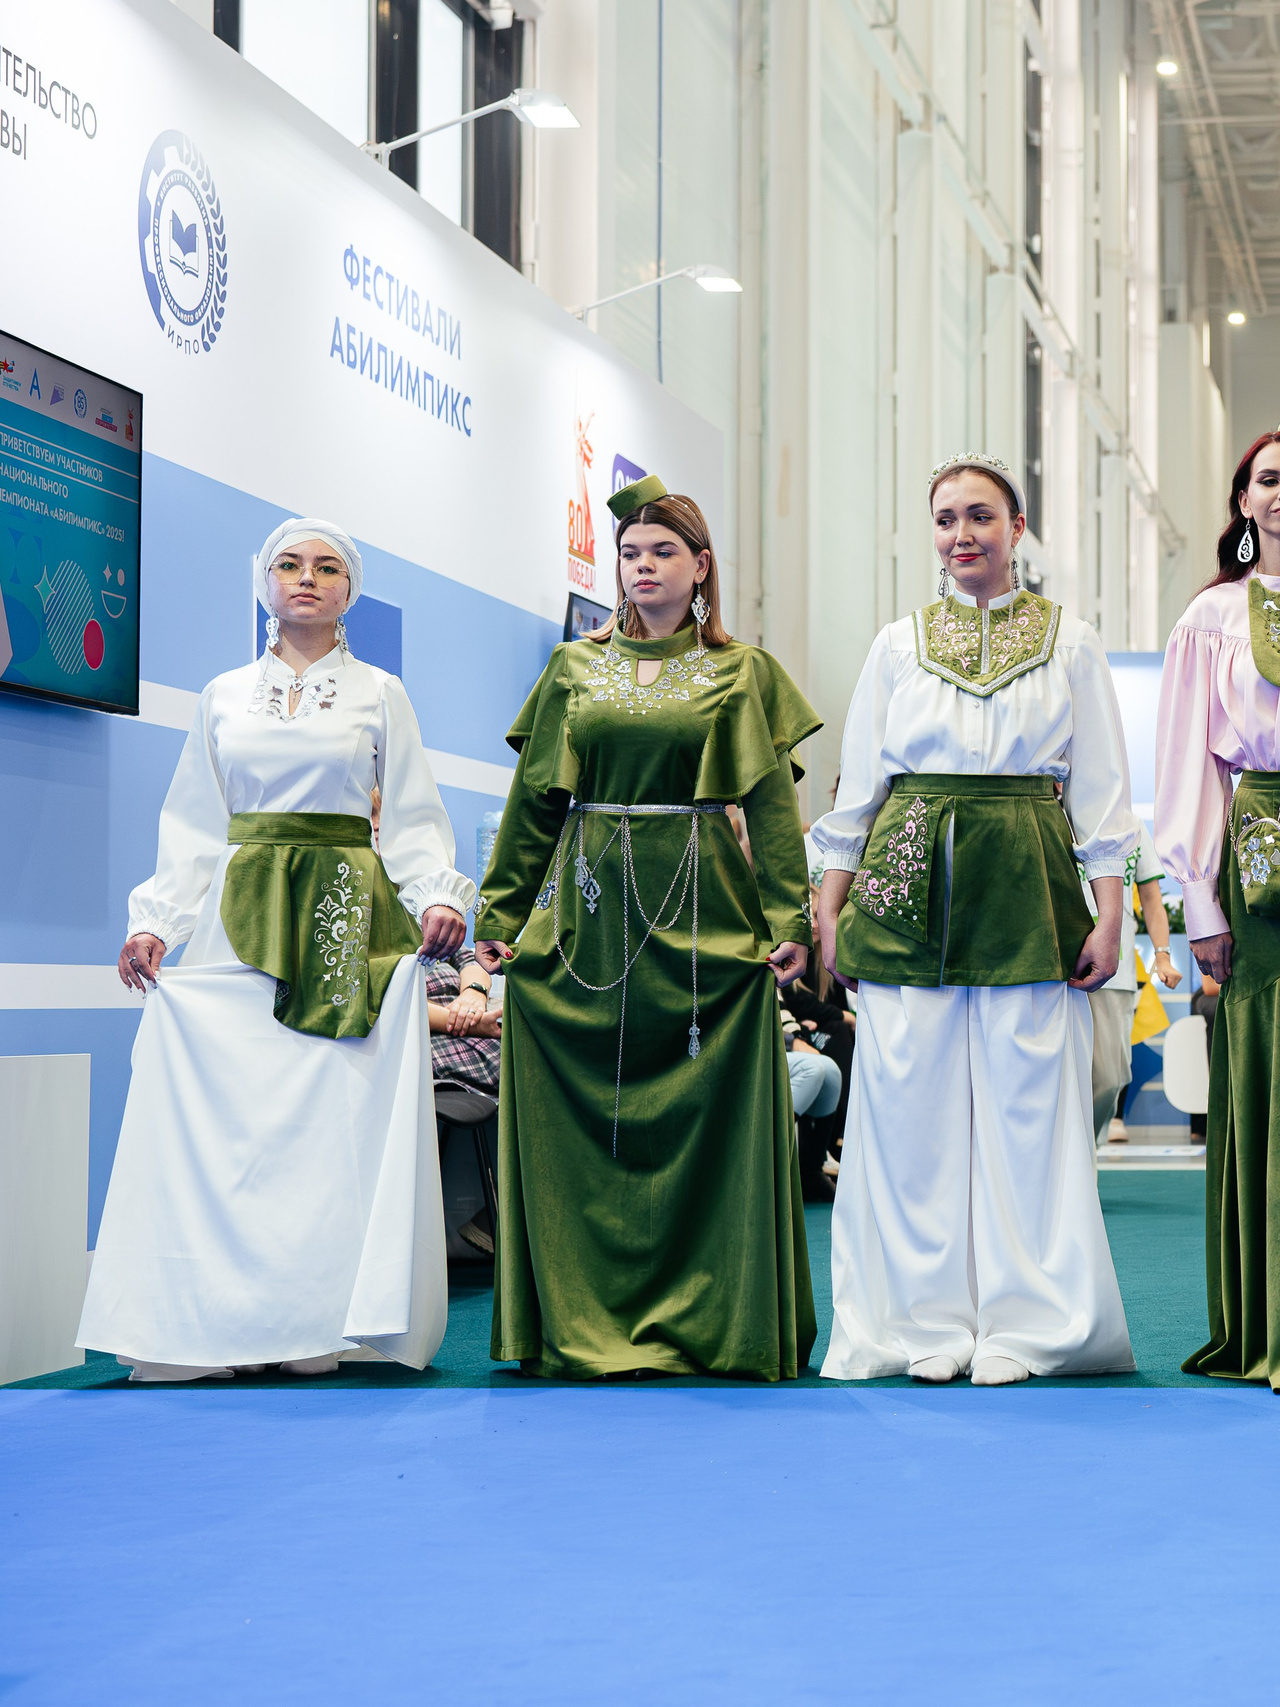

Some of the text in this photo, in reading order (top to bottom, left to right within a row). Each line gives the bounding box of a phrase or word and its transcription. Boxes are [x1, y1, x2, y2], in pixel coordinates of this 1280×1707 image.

[0, 45, 98, 140] ТЕЛЬСТВО
[343, 244, 461, 360] ФЕСТИВАЛИ
[167, 325, 200, 355] ИРПО
[329, 316, 472, 437] АБИЛИМПИКС
[56, 453, 103, 482] УЧАСТНИКОВ
[0, 487, 125, 543] ЕМПИОНАТА «АБИЛИМПИКС» 2025!
[568, 499, 586, 553] 80
[568, 556, 597, 594] ПОБЕДА!
